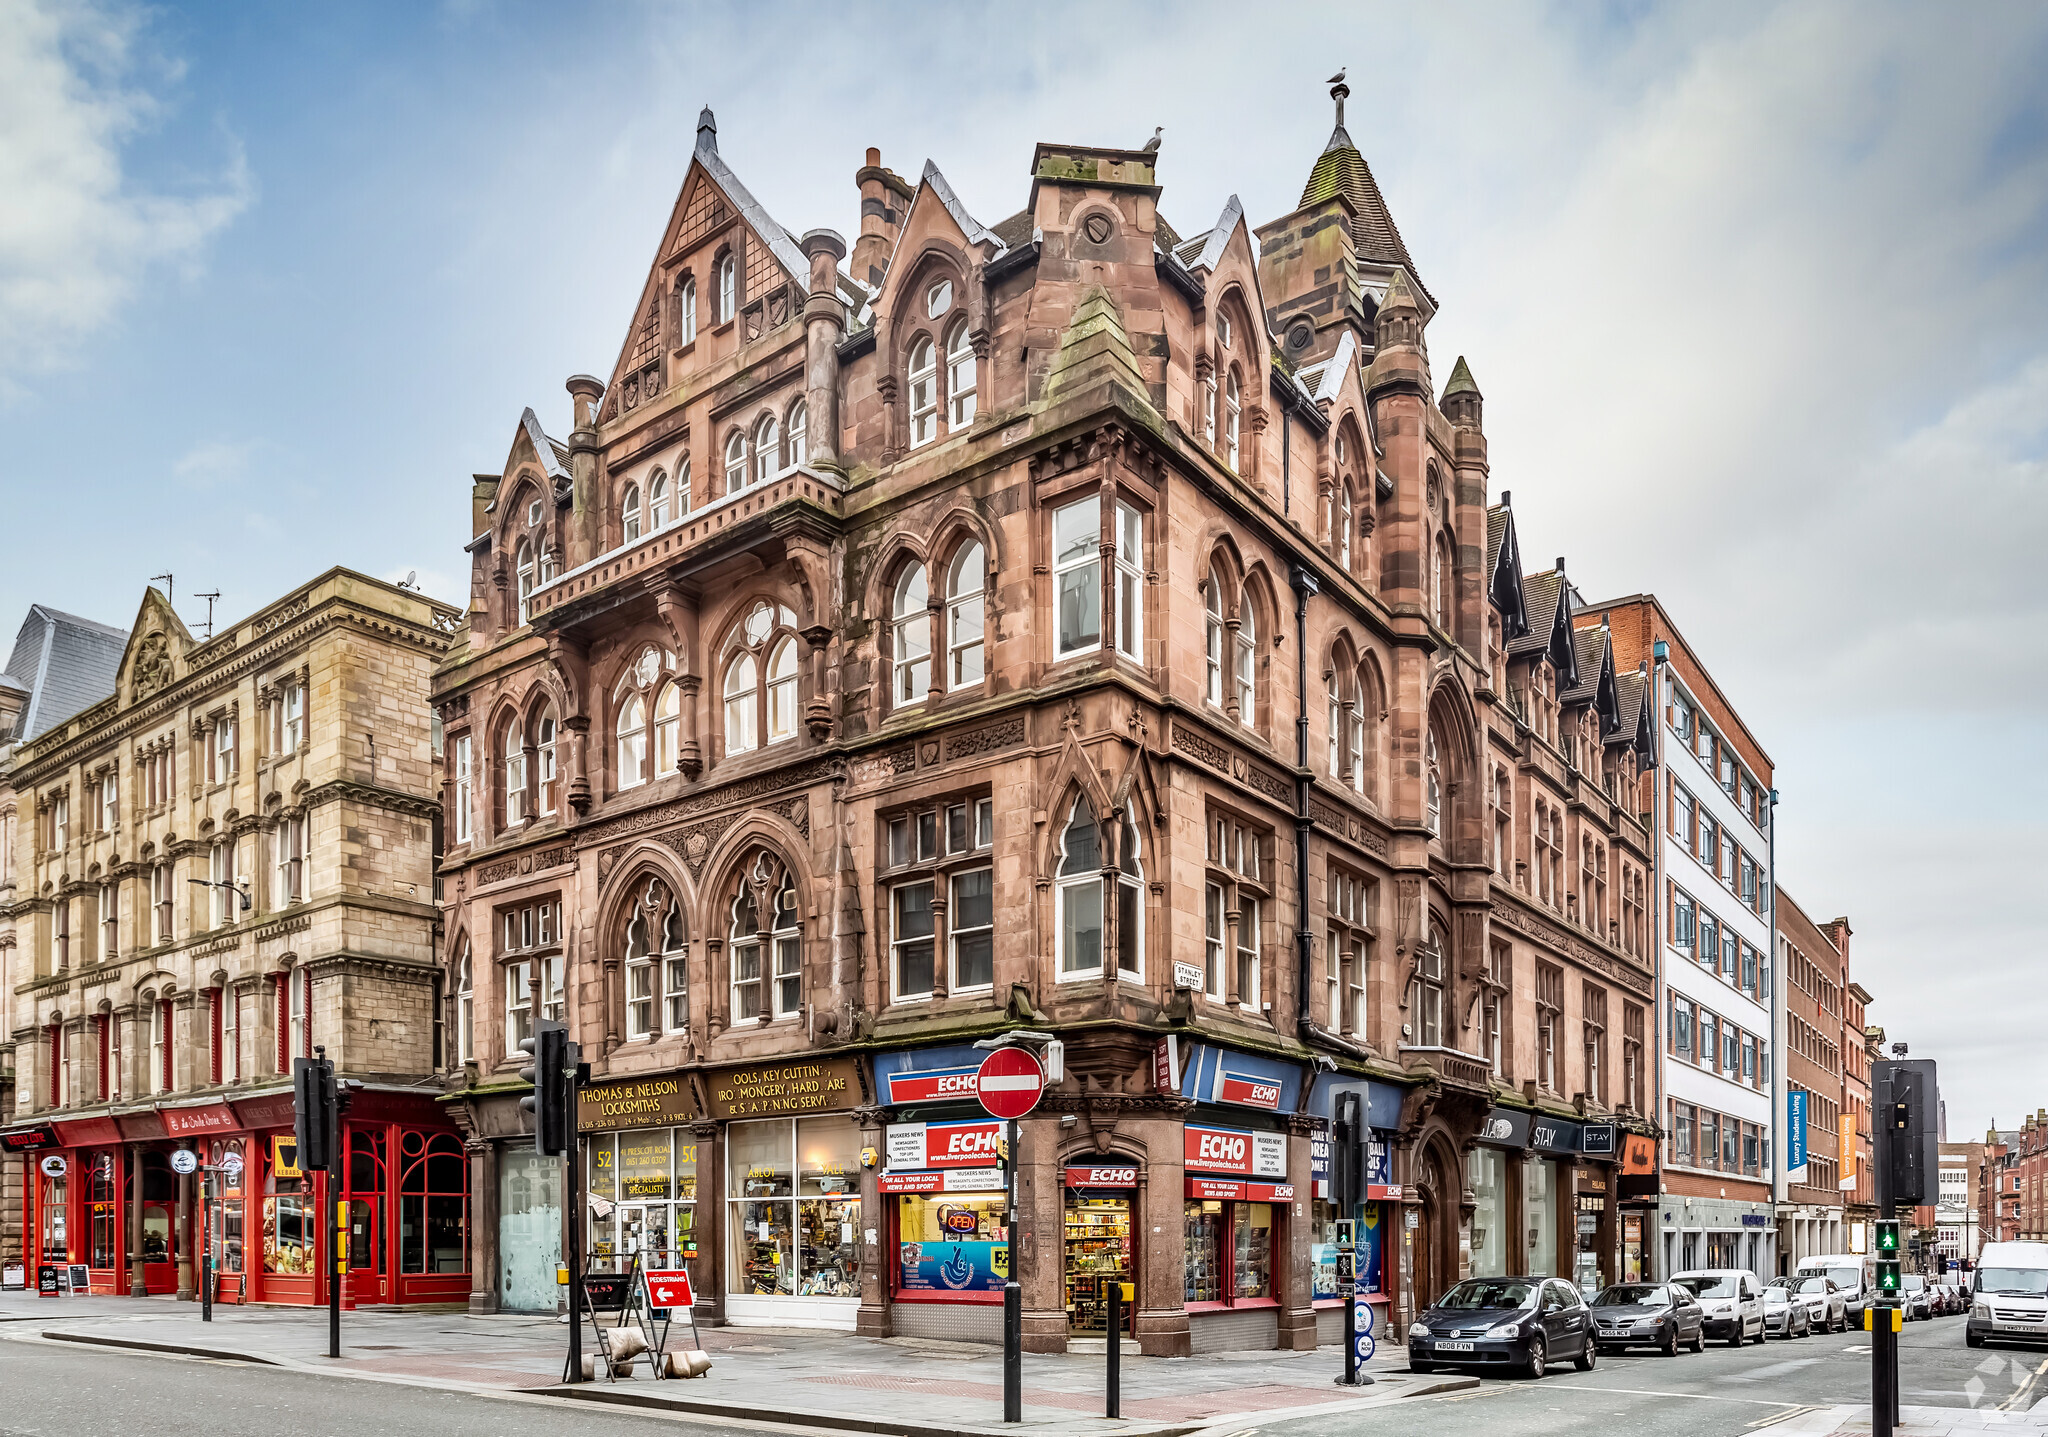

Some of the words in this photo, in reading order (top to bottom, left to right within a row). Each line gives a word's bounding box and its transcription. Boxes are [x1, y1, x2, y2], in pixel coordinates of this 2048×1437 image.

[1178, 966, 1201, 978] STANLEY
[1180, 976, 1199, 986] STREET
[731, 1072, 761, 1085] OOLS,
[763, 1069, 780, 1082] KEY
[580, 1087, 623, 1103] THOMAS
[625, 1088, 634, 1098] &
[637, 1080, 678, 1097] NELSON
[792, 1078, 846, 1094] HARDARE
[926, 1090, 978, 1098] www.liverpoolecho.co.
[1252, 1085, 1277, 1101] ECHO
[244, 1105, 274, 1118] MERSEY
[278, 1103, 294, 1115] KEB
[601, 1098, 661, 1115] LOCKSMITHS
[729, 1104, 738, 1114] &
[1793, 1095, 1801, 1115] Living
[1534, 1126, 1557, 1147] STAY
[1586, 1133, 1609, 1141] STAY
[627, 1145, 653, 1156] PRESCOT
[1200, 1134, 1246, 1161] ECHO
[1368, 1142, 1385, 1156] BALL
[1793, 1142, 1801, 1165] Luxury
[597, 1151, 612, 1167] 52
[626, 1158, 638, 1166] 0151
[651, 1155, 667, 1164] 0309
[1185, 1158, 1246, 1169] www.liverpoolecho.co.uk
[1368, 1156, 1380, 1170] OLS
[821, 1163, 844, 1175] YALE
[1311, 1160, 1324, 1171] OME
[747, 1167, 775, 1177] ABLOY
[1089, 1169, 1136, 1181] ECHO
[621, 1175, 640, 1184] HOME
[642, 1174, 671, 1183] SECURITY
[628, 1185, 664, 1194] SPECIALISTS
[1274, 1186, 1294, 1197] ECHO
[1387, 1186, 1402, 1196] ECHO
[949, 1216, 975, 1229] OPEN
[1437, 1342, 1456, 1350] NB08
